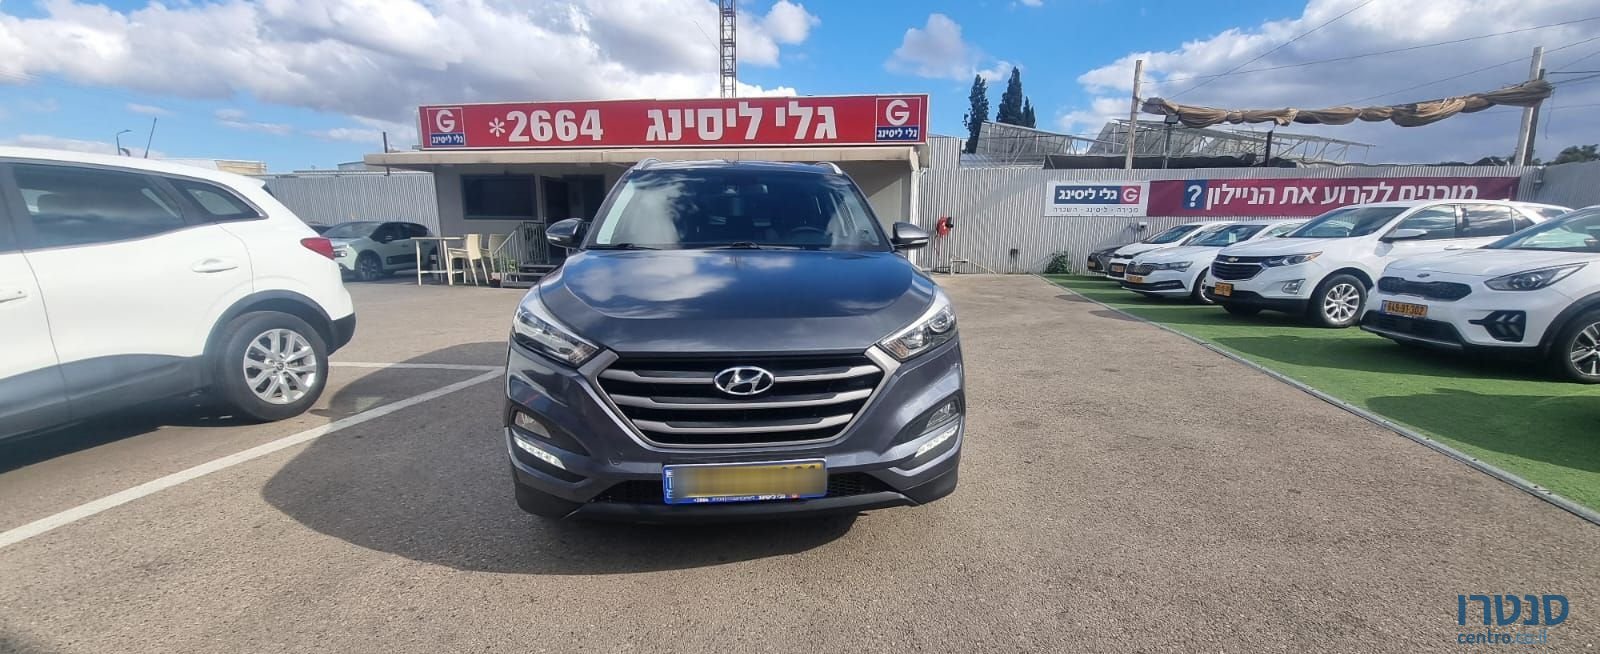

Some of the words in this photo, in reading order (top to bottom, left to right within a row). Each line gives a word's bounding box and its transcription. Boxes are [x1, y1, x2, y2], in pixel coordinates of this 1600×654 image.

[435, 109, 456, 133] G
[645, 101, 763, 142] ליסינג
[775, 101, 838, 140] גלי
[885, 99, 910, 126] G
[877, 127, 903, 138] ליסינג
[905, 127, 918, 138] גלי
[1058, 187, 1096, 200] ליסינג
[1099, 187, 1118, 200] גלי
[1122, 187, 1139, 202] G
[1205, 183, 1276, 211] הניילון
[1279, 186, 1318, 205] את
[1320, 181, 1394, 205] לקרוע
[1398, 184, 1478, 200] מוכנים
